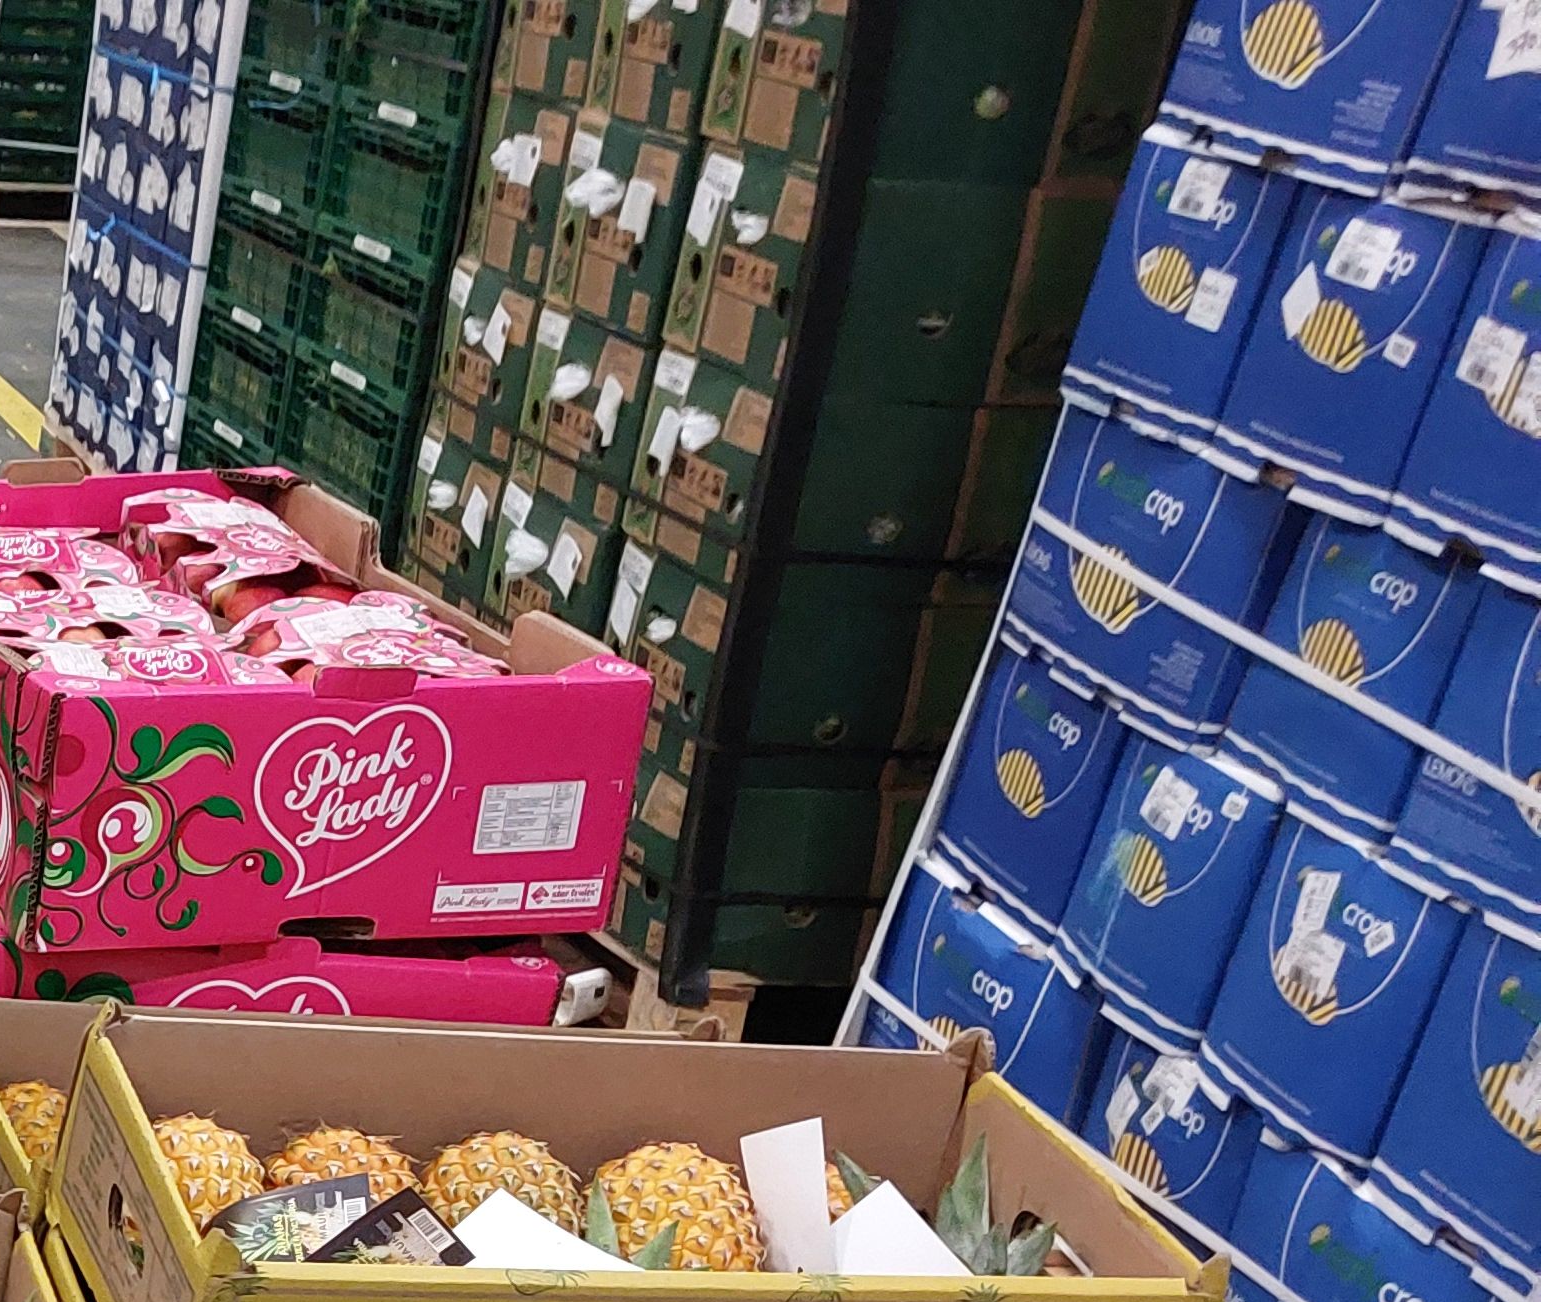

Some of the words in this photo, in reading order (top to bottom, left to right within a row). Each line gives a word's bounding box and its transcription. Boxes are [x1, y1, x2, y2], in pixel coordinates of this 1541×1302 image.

[142, 650, 193, 676] Pink
[284, 721, 415, 811] Pink
[295, 773, 419, 847] Lady
